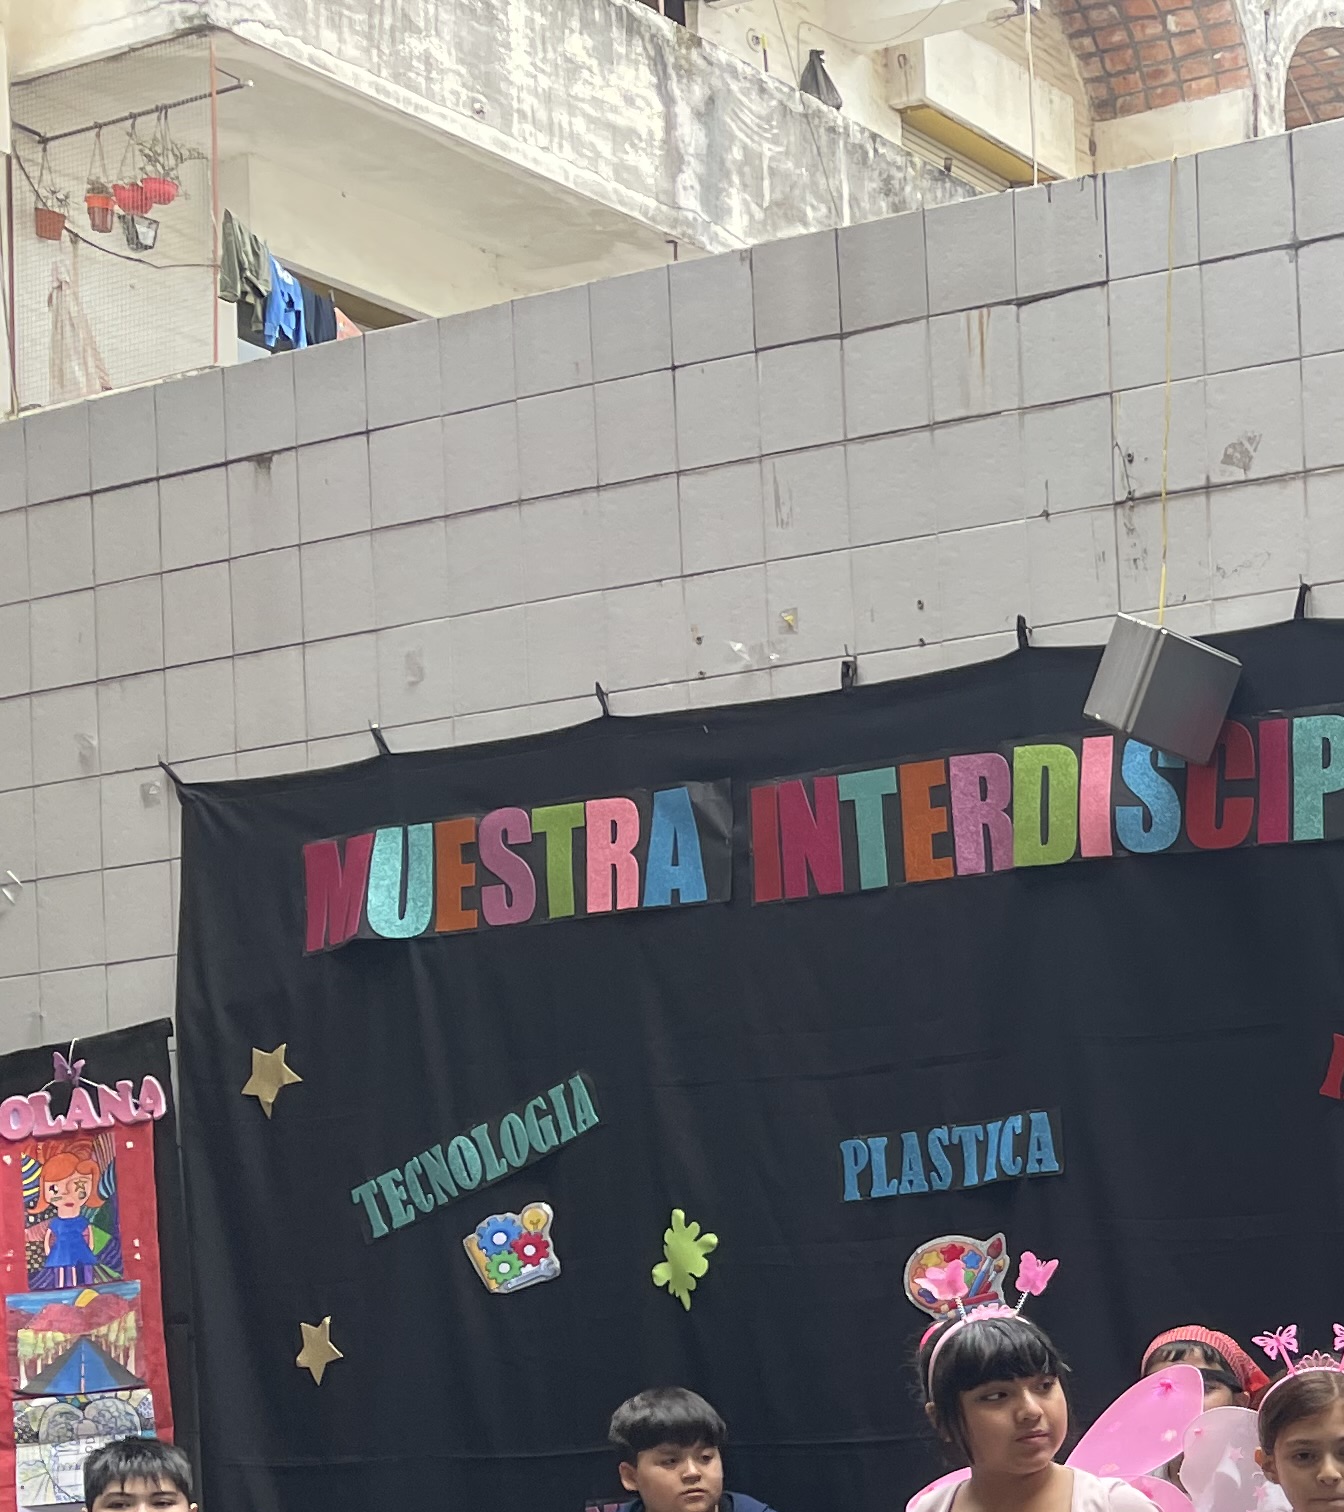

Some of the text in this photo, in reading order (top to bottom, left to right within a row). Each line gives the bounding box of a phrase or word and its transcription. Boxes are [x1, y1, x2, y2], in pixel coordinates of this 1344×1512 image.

[303, 786, 708, 953] MUESTRA
[351, 1073, 600, 1240] TECNOLOGIA
[838, 1111, 1060, 1201] PLASTICA
